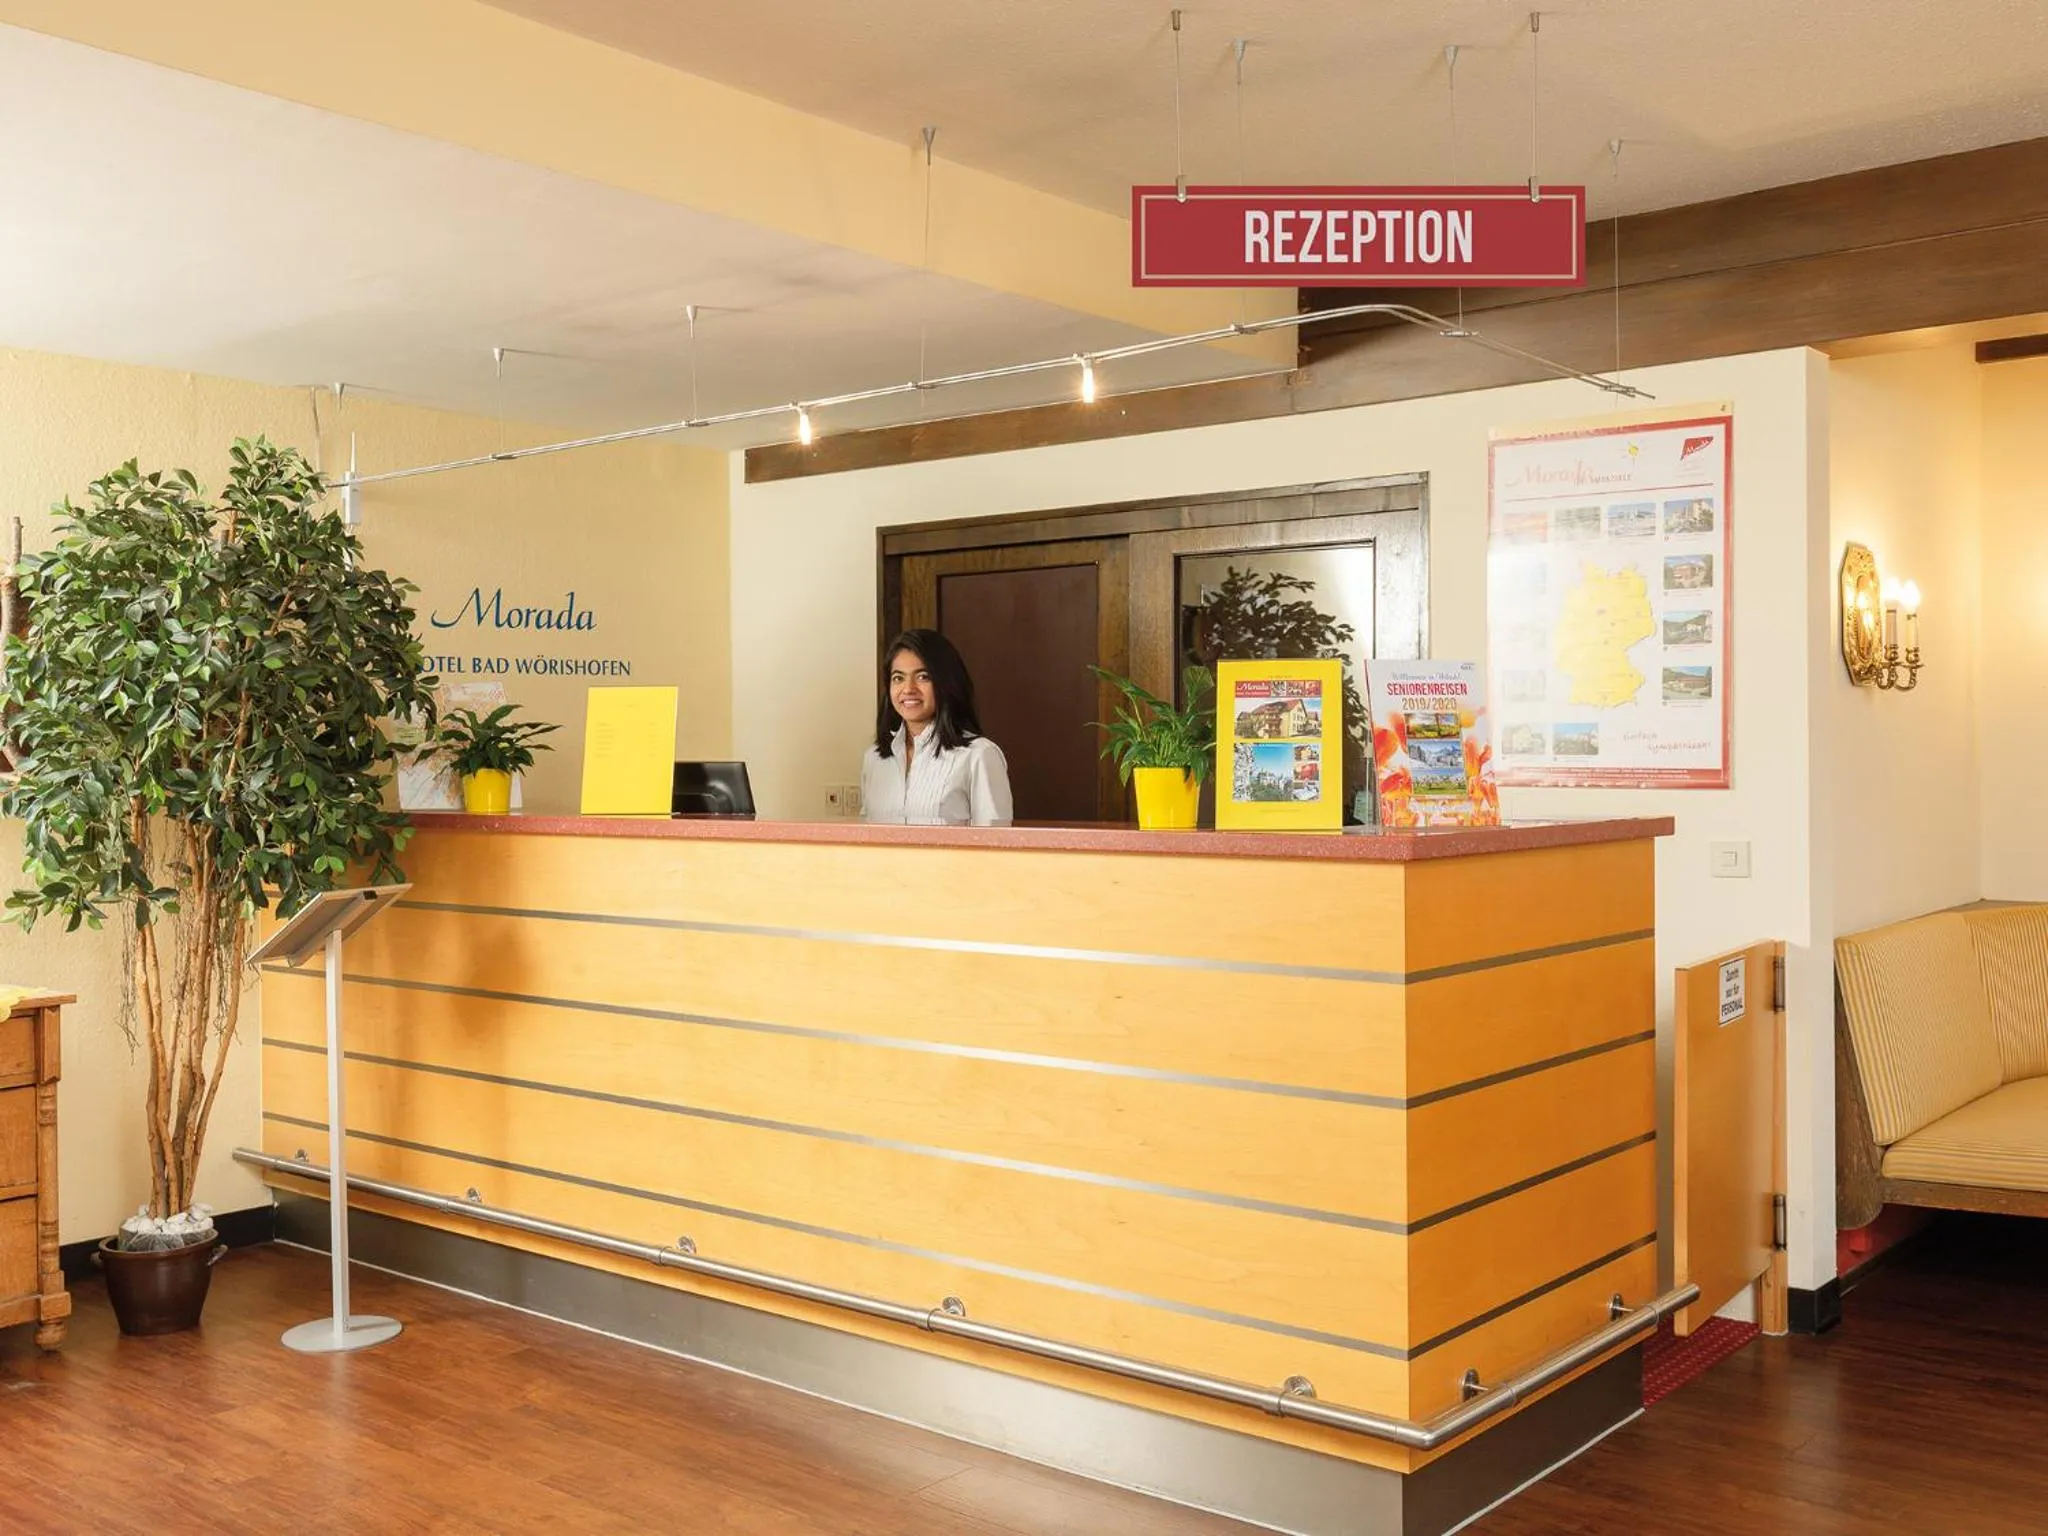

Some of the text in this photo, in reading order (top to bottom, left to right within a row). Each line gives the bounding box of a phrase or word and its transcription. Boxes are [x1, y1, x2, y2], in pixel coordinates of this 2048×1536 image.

[1244, 209, 1473, 264] REZEPTION
[431, 587, 597, 631] Morada
[418, 654, 631, 676] OTEL BAD WÖRISHOFEN
[1386, 682, 1468, 696] SENIORENREISEN
[1401, 697, 1457, 711] 2019/2020
